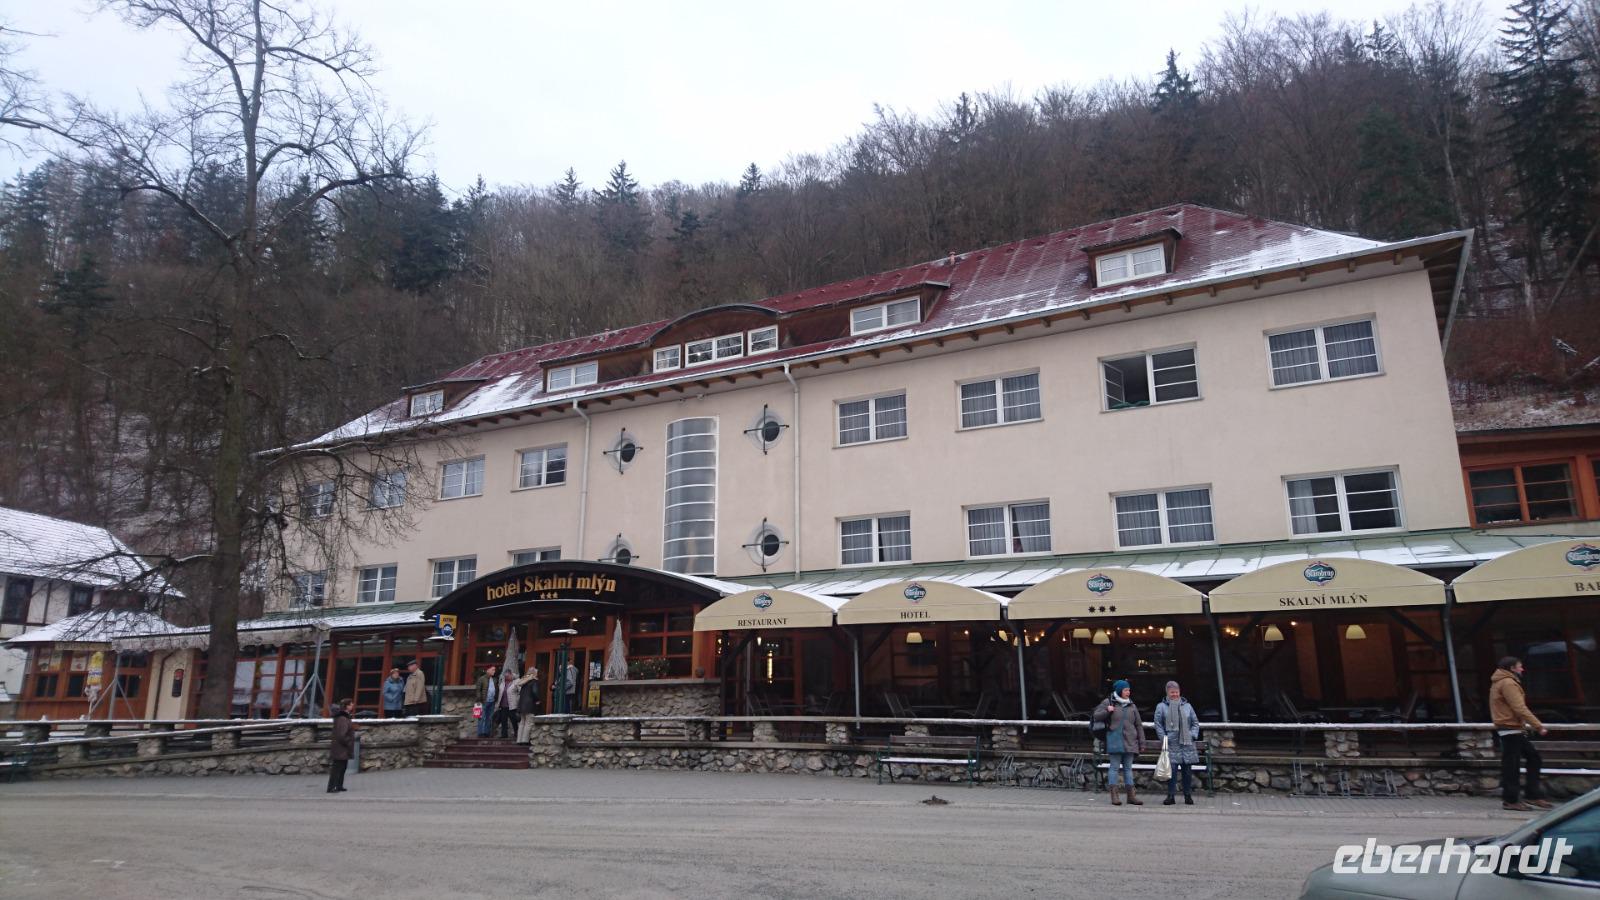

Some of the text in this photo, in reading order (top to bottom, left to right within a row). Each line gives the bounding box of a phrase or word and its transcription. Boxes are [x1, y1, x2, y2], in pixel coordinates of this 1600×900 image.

[487, 573, 616, 600] hotel Skalní mlýn
[1280, 593, 1368, 607] SKALNÍ MLÝN
[900, 611, 931, 619] HOTEL
[737, 617, 788, 627] RESTAURANT
